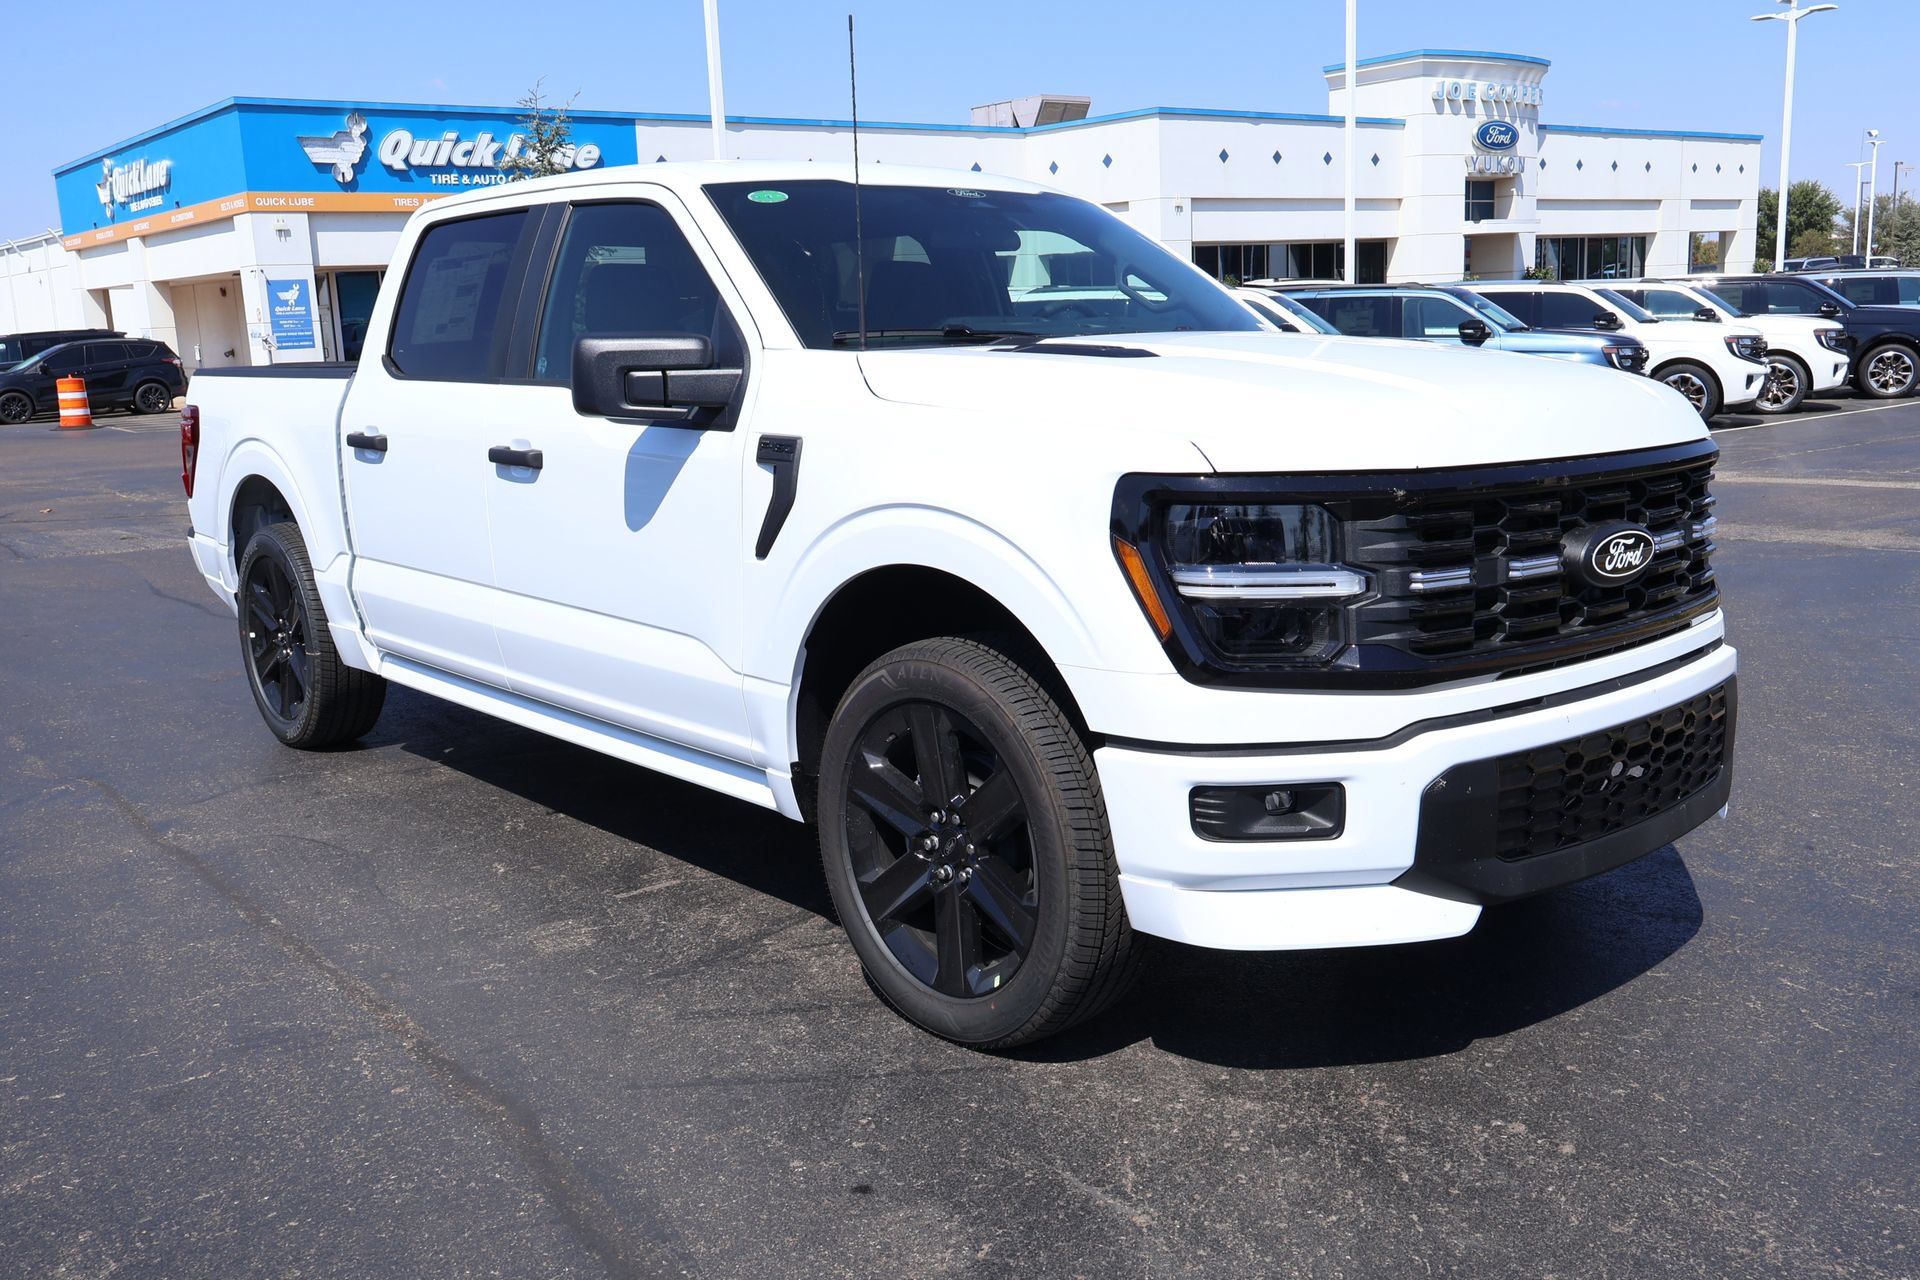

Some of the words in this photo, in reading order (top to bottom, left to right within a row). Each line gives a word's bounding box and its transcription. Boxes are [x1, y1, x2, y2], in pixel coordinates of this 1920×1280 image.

[1433, 81, 1477, 100] JOE
[1486, 126, 1512, 144] Ford
[378, 128, 502, 171] Quick
[1468, 156, 1526, 174] YUKON
[112, 160, 141, 203] Quick
[140, 160, 168, 192] Lane
[430, 174, 459, 185] TIRE
[462, 174, 471, 185] &
[473, 174, 506, 185] AUTO
[255, 197, 285, 207] QUICK
[289, 197, 314, 206] LUBE
[392, 197, 419, 207] TIRES
[1605, 537, 1644, 571] Ford
